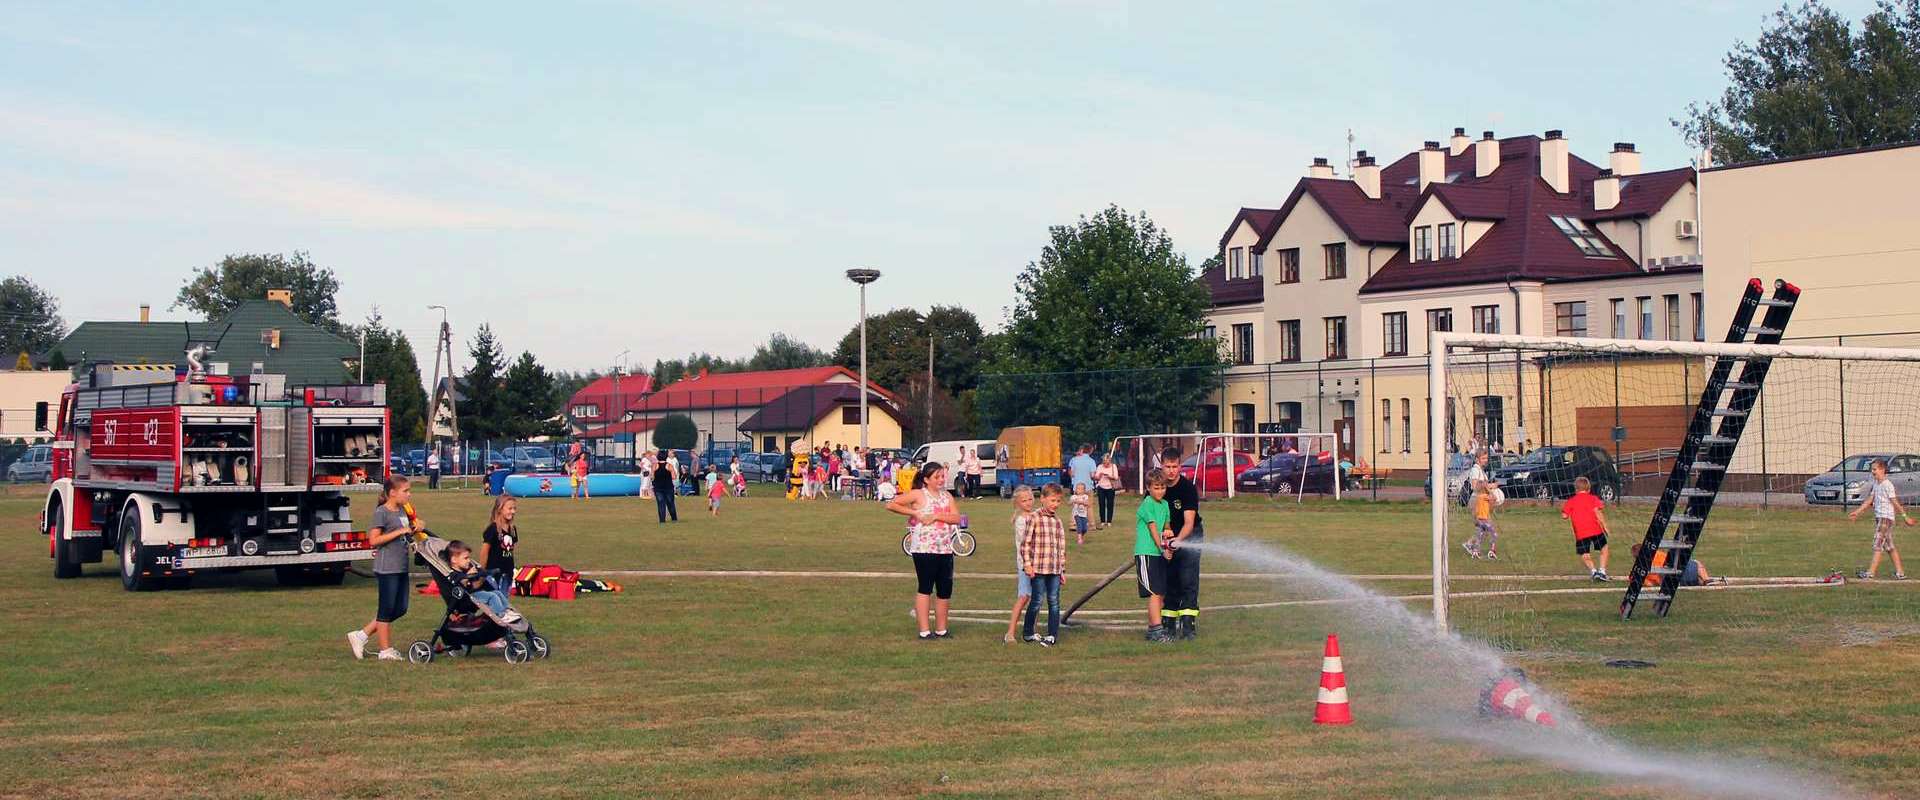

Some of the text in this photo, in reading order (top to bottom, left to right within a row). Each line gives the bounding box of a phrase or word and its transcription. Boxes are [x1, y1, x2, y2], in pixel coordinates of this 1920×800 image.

[104, 419, 117, 446] 567
[148, 418, 159, 446] 23
[334, 541, 363, 550] JELCZ
